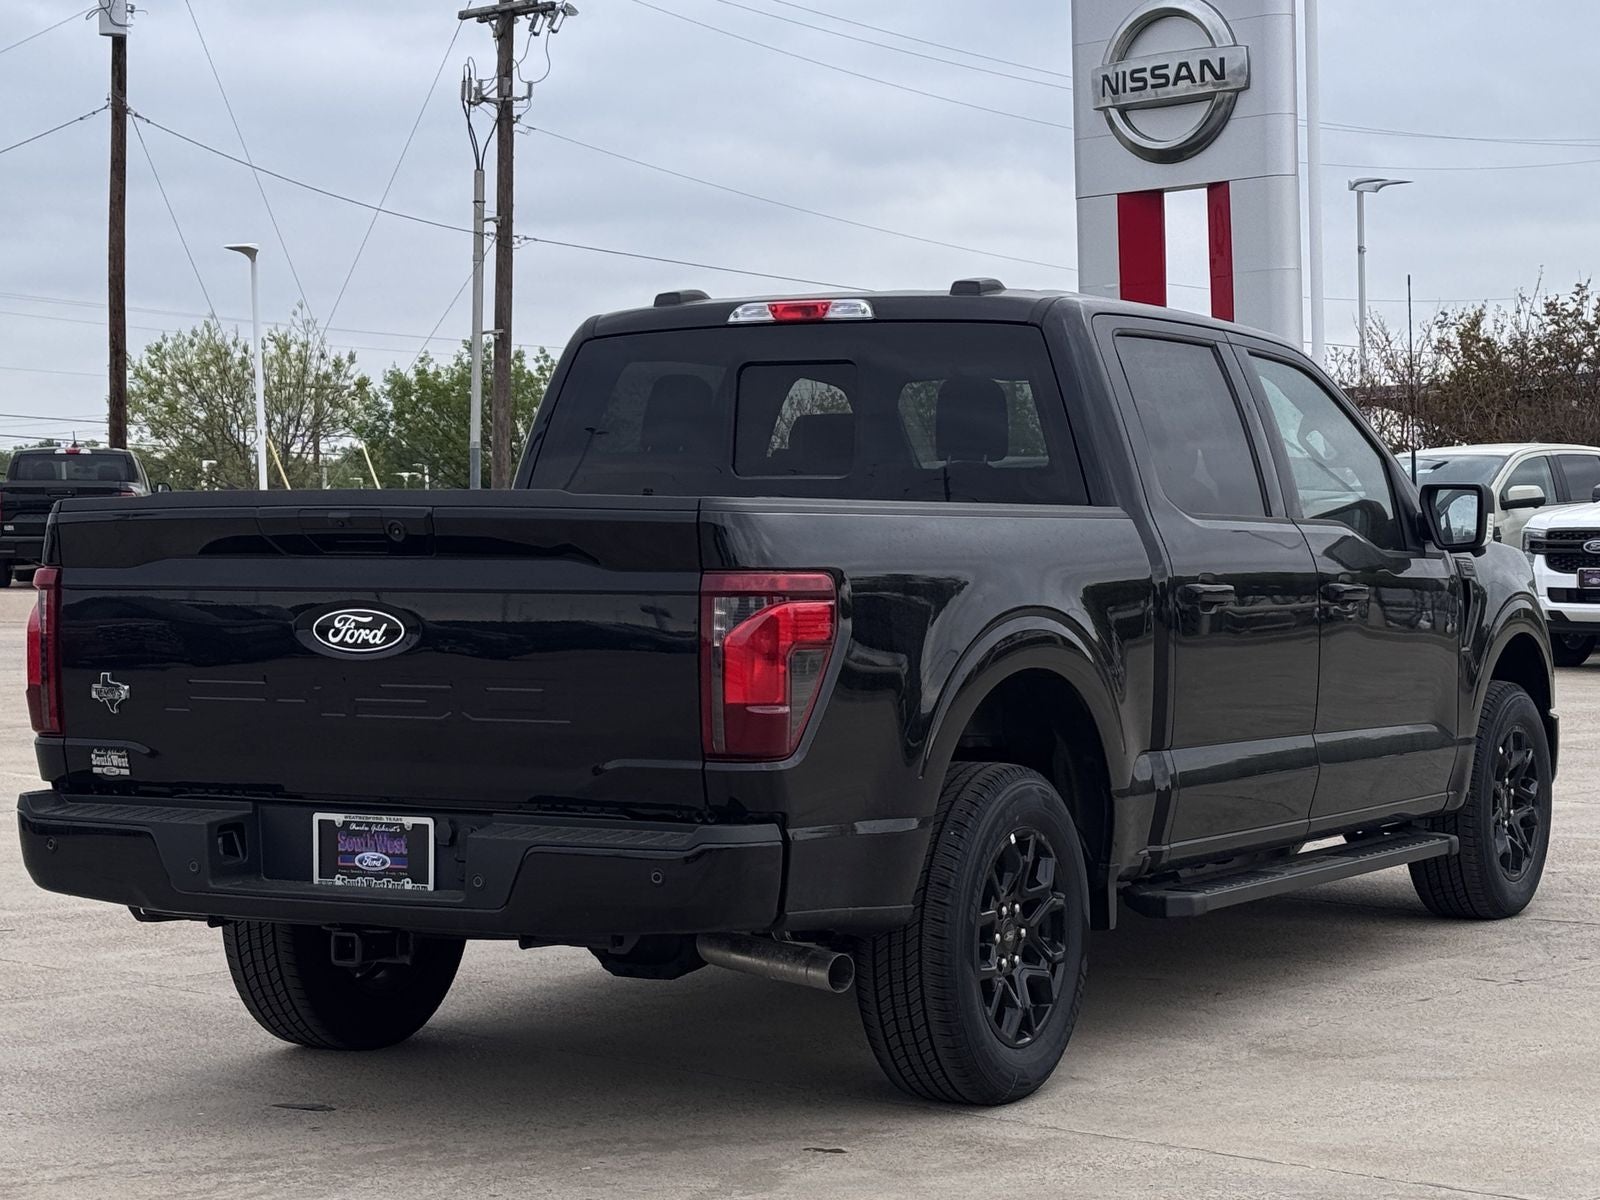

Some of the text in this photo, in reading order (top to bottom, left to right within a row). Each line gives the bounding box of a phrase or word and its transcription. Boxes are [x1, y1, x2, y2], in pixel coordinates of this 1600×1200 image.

[1102, 57, 1226, 98] NISSAN
[328, 614, 388, 644] Ford
[95, 686, 125, 699] TEXAS
[362, 855, 383, 867] Ford
